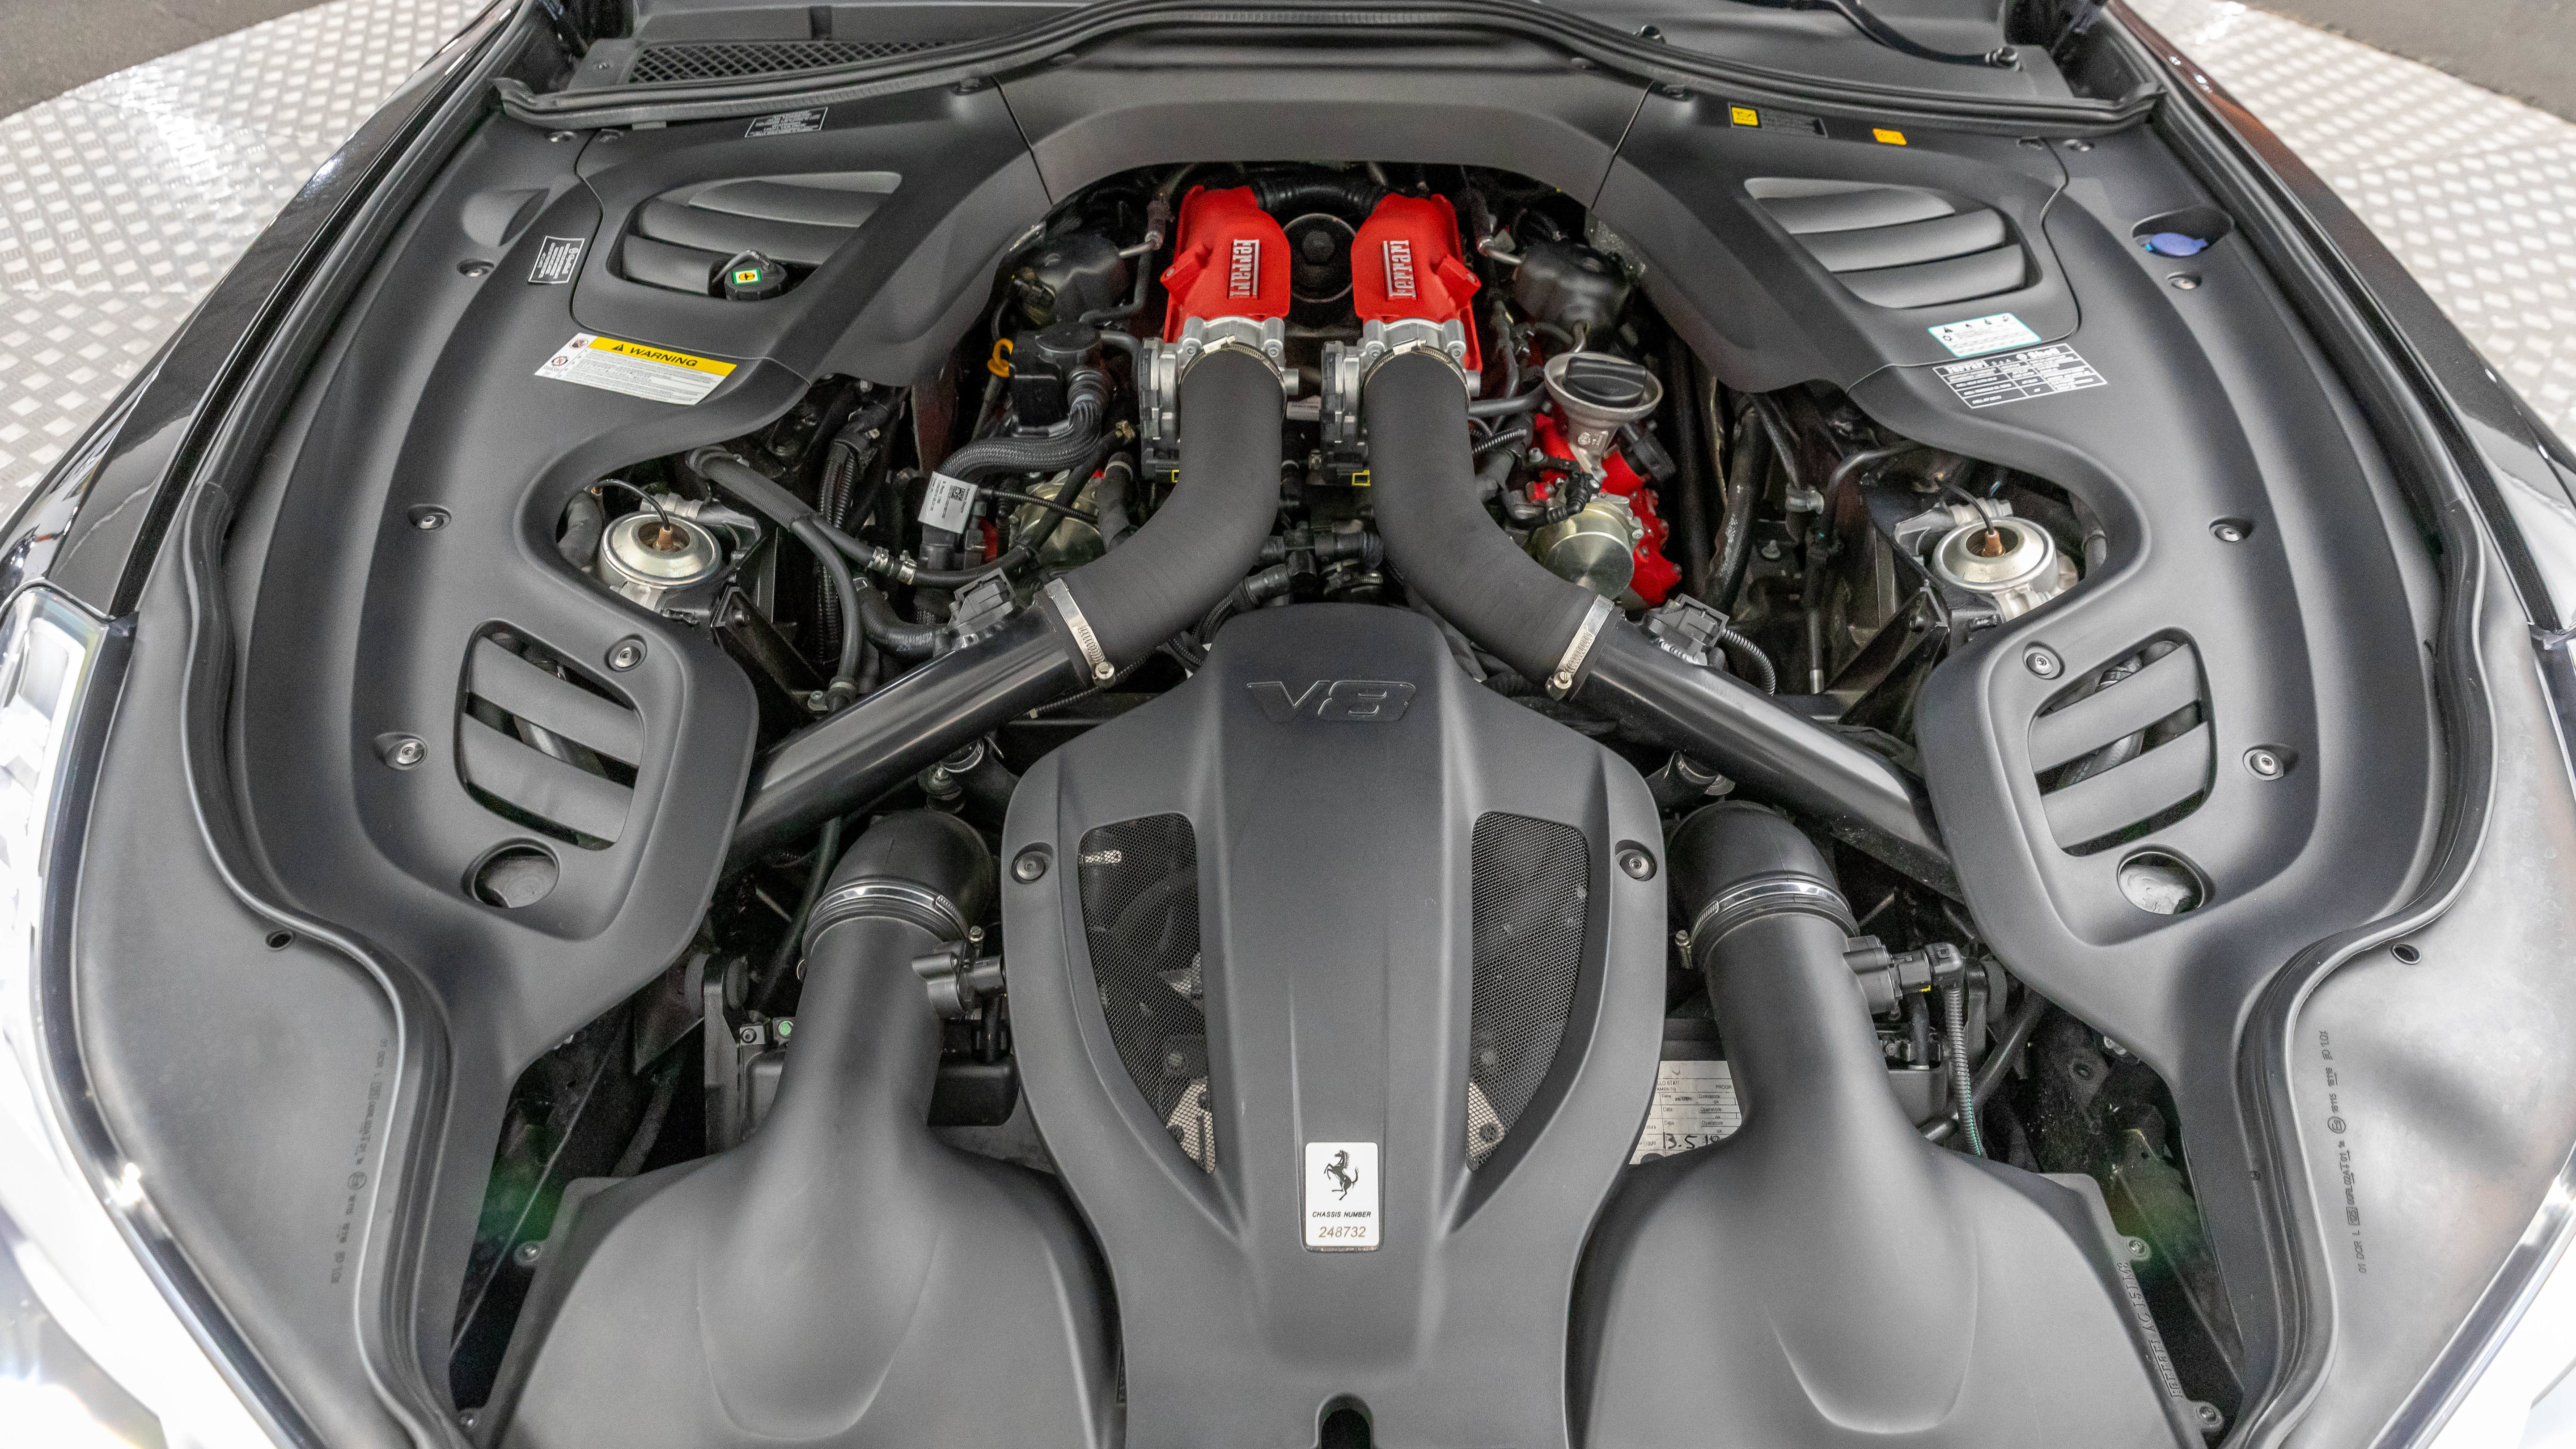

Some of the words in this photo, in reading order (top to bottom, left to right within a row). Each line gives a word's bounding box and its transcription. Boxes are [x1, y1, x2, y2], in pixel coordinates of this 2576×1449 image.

[1230, 239, 1259, 296] Ferrari
[1383, 240, 1416, 297] Ferrari
[630, 347, 698, 366] WARNING
[1246, 680, 1416, 723] V8
[1318, 1226, 1366, 1238] 248732
